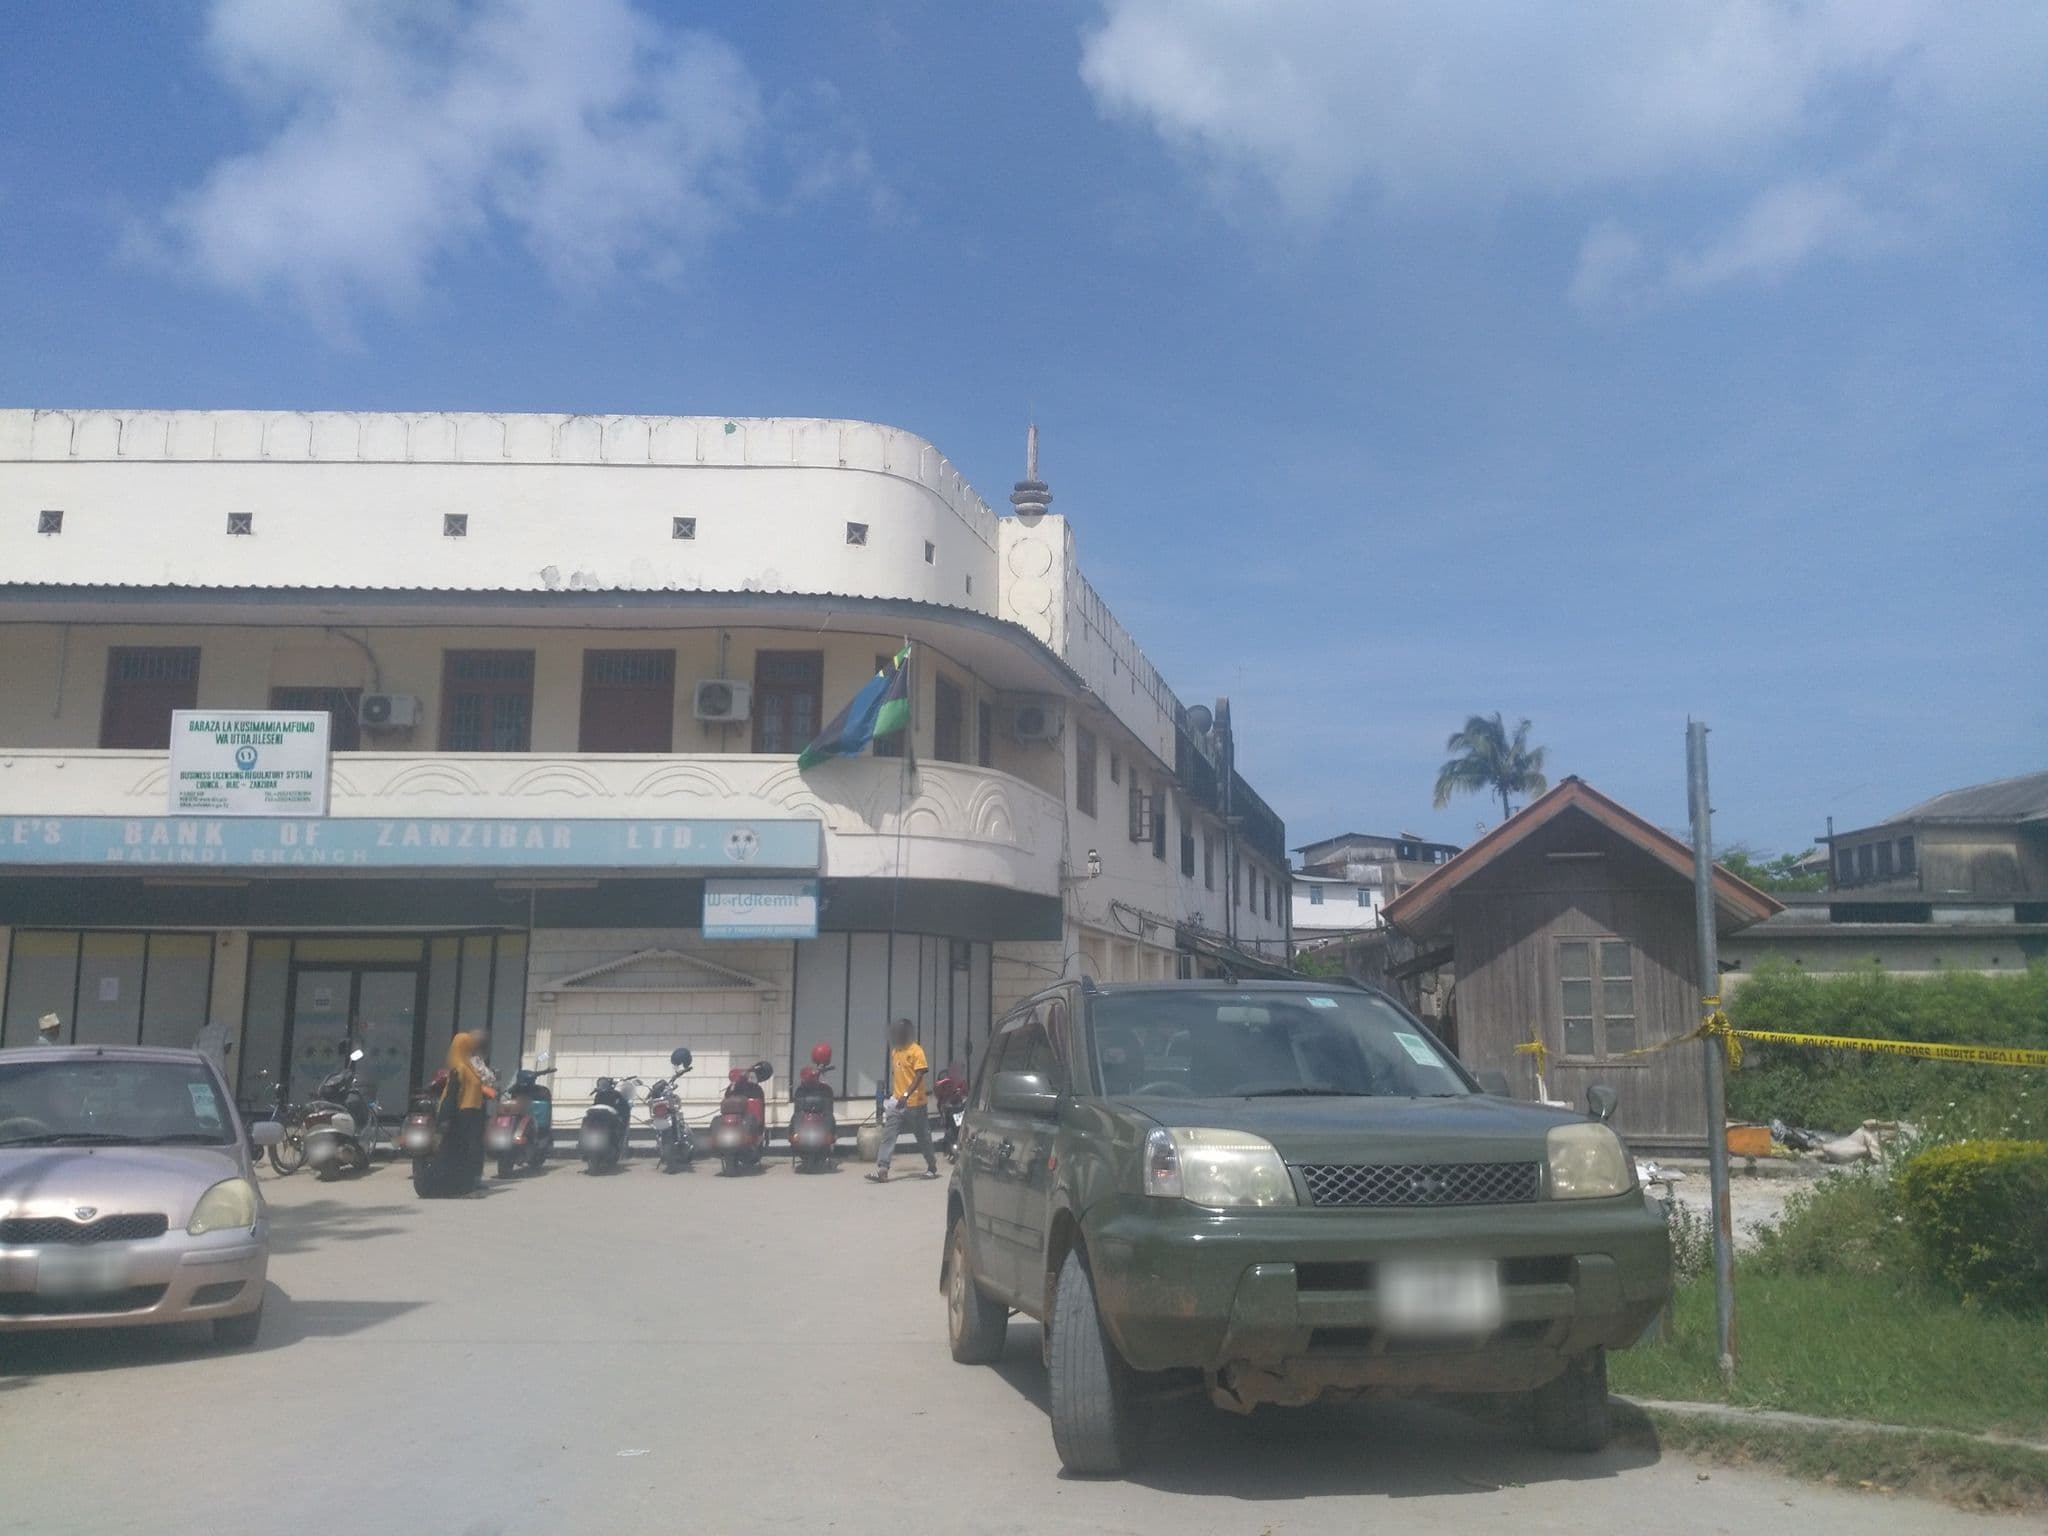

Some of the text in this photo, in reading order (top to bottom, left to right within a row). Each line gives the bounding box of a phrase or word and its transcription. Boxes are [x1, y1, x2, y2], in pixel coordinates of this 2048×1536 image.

[189, 720, 220, 731] BARAZA
[222, 720, 231, 731] LA
[283, 721, 315, 733] MFUMO
[180, 771, 211, 780] BUSINESS
[286, 770, 312, 779] SYSTEM
[0, 821, 707, 849] E'S BANK OF ZANZIBAR LTD.
[107, 847, 368, 863] MALINDI BRANCH
[1802, 1037, 1834, 1049] POLICE
[1837, 1040, 1857, 1050] LINE
[1860, 1042, 1873, 1052] DO
[1876, 1043, 1896, 1054] NOT
[1898, 1045, 1931, 1057] CROSS
